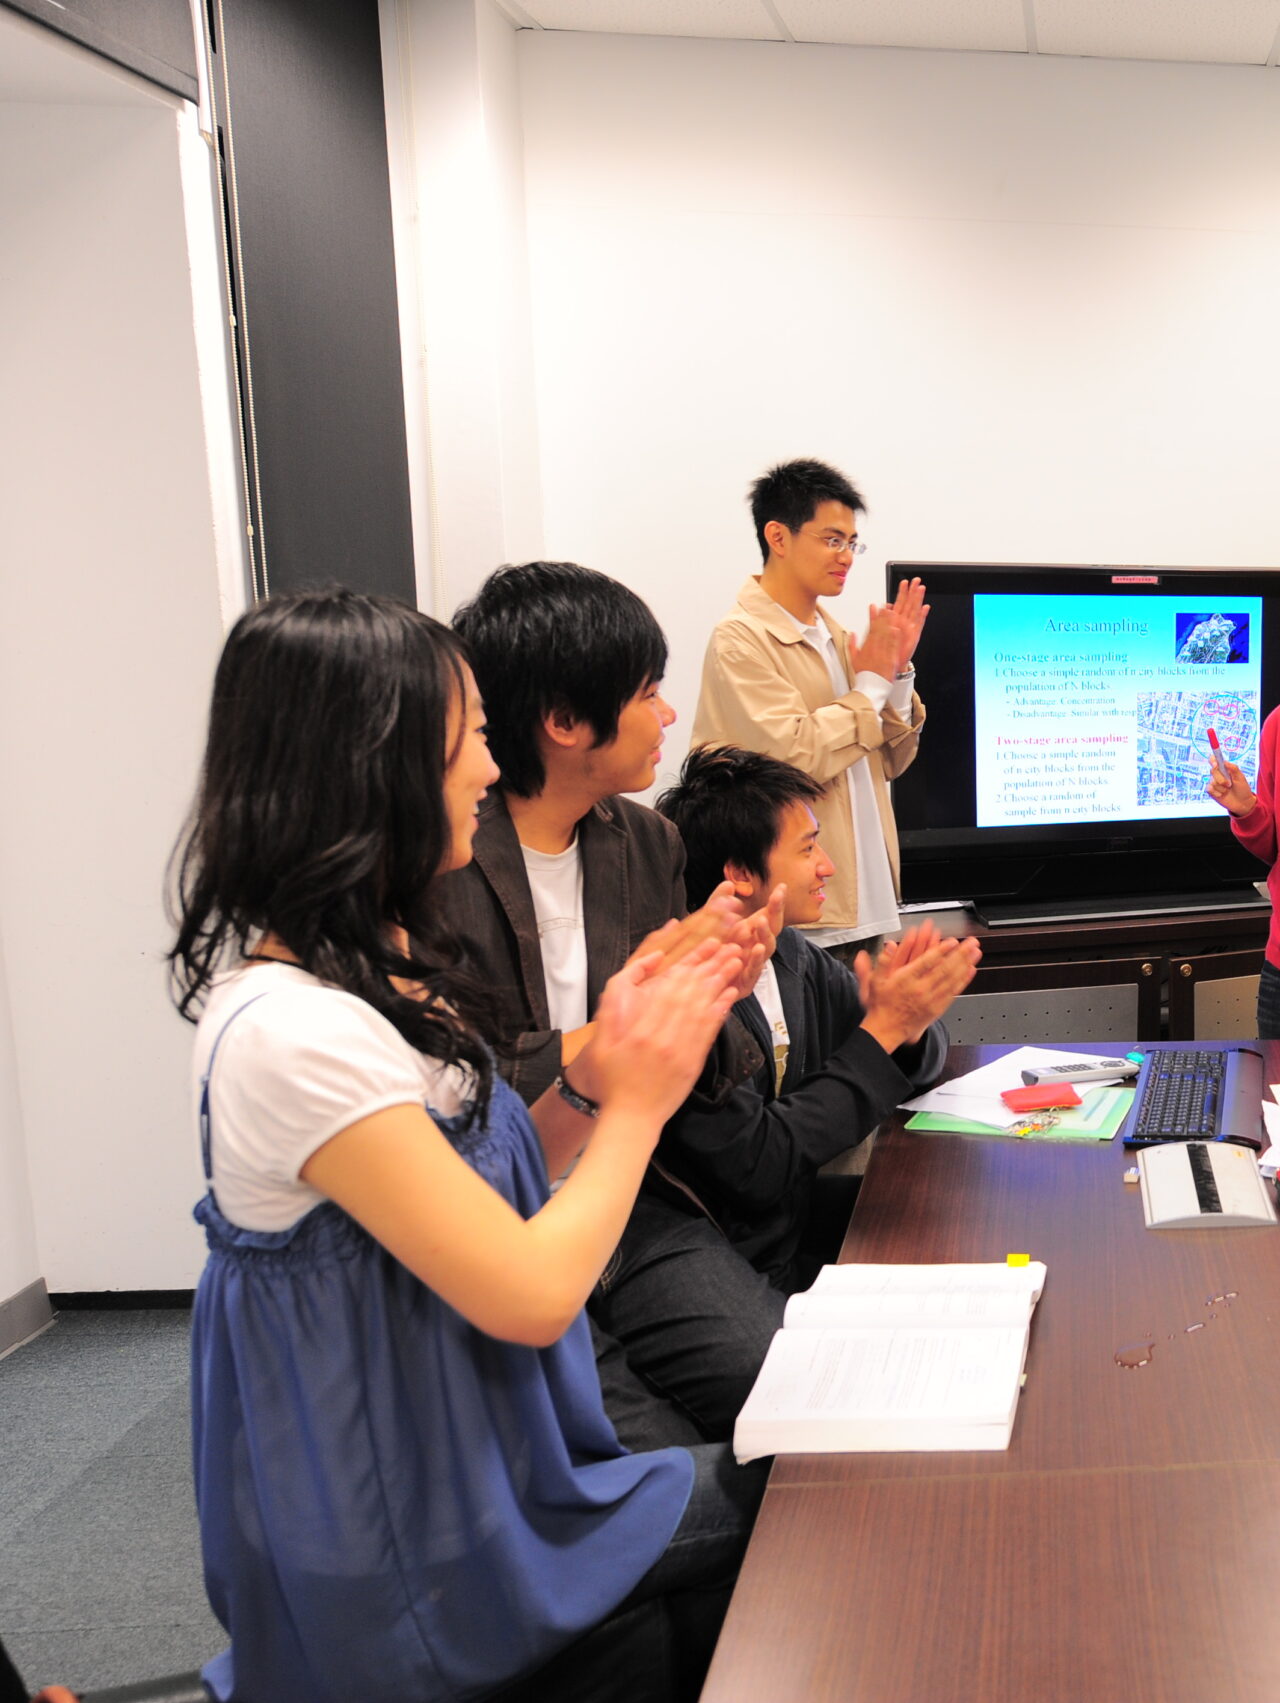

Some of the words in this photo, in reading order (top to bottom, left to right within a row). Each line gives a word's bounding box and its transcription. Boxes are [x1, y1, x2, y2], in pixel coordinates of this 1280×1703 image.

[1044, 618, 1079, 633] Area
[1083, 617, 1150, 636] sampling
[994, 652, 1051, 664] One-stage
[1052, 654, 1076, 663] area
[1079, 652, 1128, 665] sampling
[1040, 669, 1046, 677] a
[1049, 668, 1079, 679] simple
[1081, 667, 1116, 677] random
[1158, 666, 1187, 676] blocks
[1189, 666, 1209, 676] from
[1212, 665, 1226, 675] the
[1005, 682, 1056, 694] population
[1060, 696, 1116, 705] Concentration
[996, 736, 1051, 746] Two-stage
[1054, 737, 1078, 745] area
[1080, 734, 1129, 747] sampling
[1049, 749, 1079, 761] simple
[1081, 749, 1116, 759] random
[1003, 764, 1014, 774] of
[1024, 765, 1041, 777] city
[1044, 763, 1075, 773] blocks
[1077, 763, 1099, 773] from
[1101, 762, 1116, 772] the
[1003, 778, 1054, 791] population
[1049, 791, 1084, 801] random
[1086, 790, 1097, 800] of
[1004, 806, 1037, 819] sample
[1040, 805, 1062, 816] from
[1072, 805, 1088, 817] city
